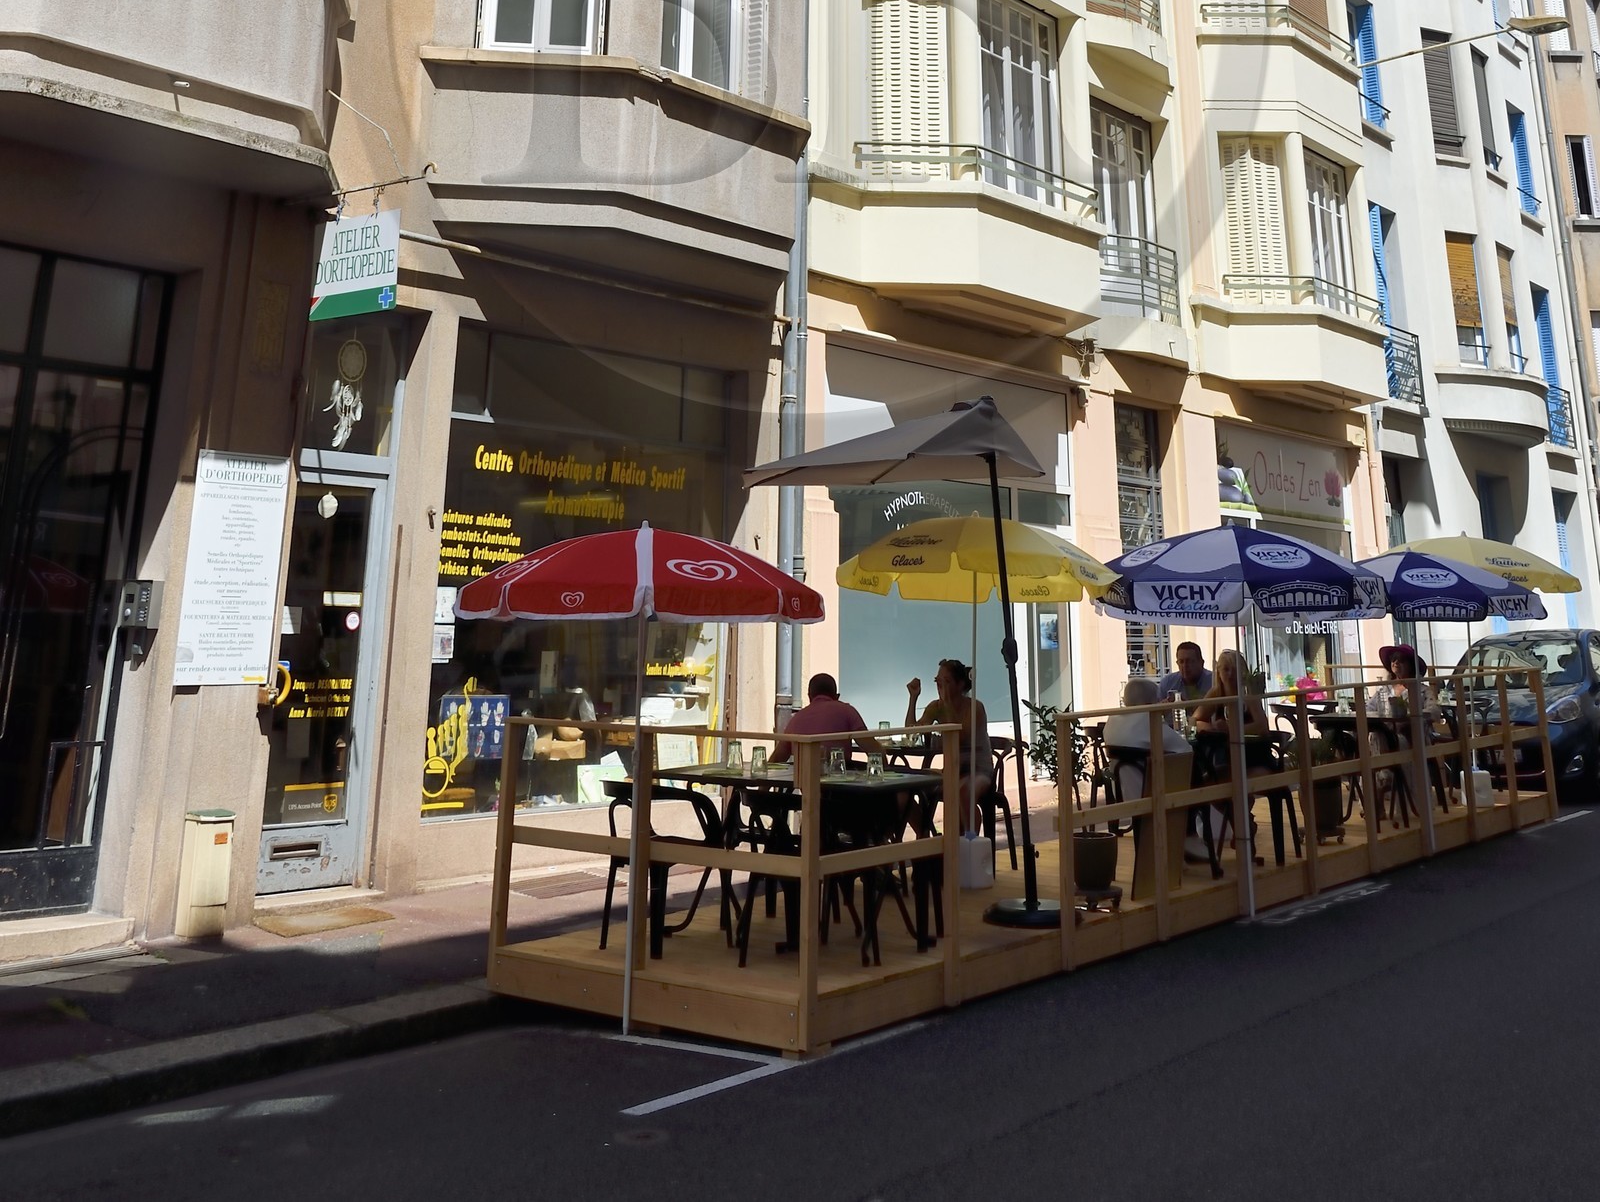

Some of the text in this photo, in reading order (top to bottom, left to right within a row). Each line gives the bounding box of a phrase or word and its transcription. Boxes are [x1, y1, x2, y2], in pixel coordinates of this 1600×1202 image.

[331, 225, 380, 256] ATELIER
[315, 249, 395, 286] D'ORTHOPEDIE
[224, 458, 267, 471] ATELIER
[475, 444, 686, 491] Centre Orthopédique et Médico Sportif
[205, 469, 283, 485] D'ORTHOPEDIE
[1253, 451, 1321, 502] Ondes Zen
[442, 508, 512, 529] eintures médicales
[441, 526, 521, 547] ombostats.Contention
[891, 554, 925, 567] Glaces
[1250, 549, 1299, 558] VICHY
[1501, 572, 1529, 583] Glaces
[1151, 581, 1225, 601] VICHY
[1159, 596, 1220, 611] Célestins
[1496, 595, 1528, 611] VICHY
[288, 707, 305, 718] Anne
[325, 799, 336, 810] ups
